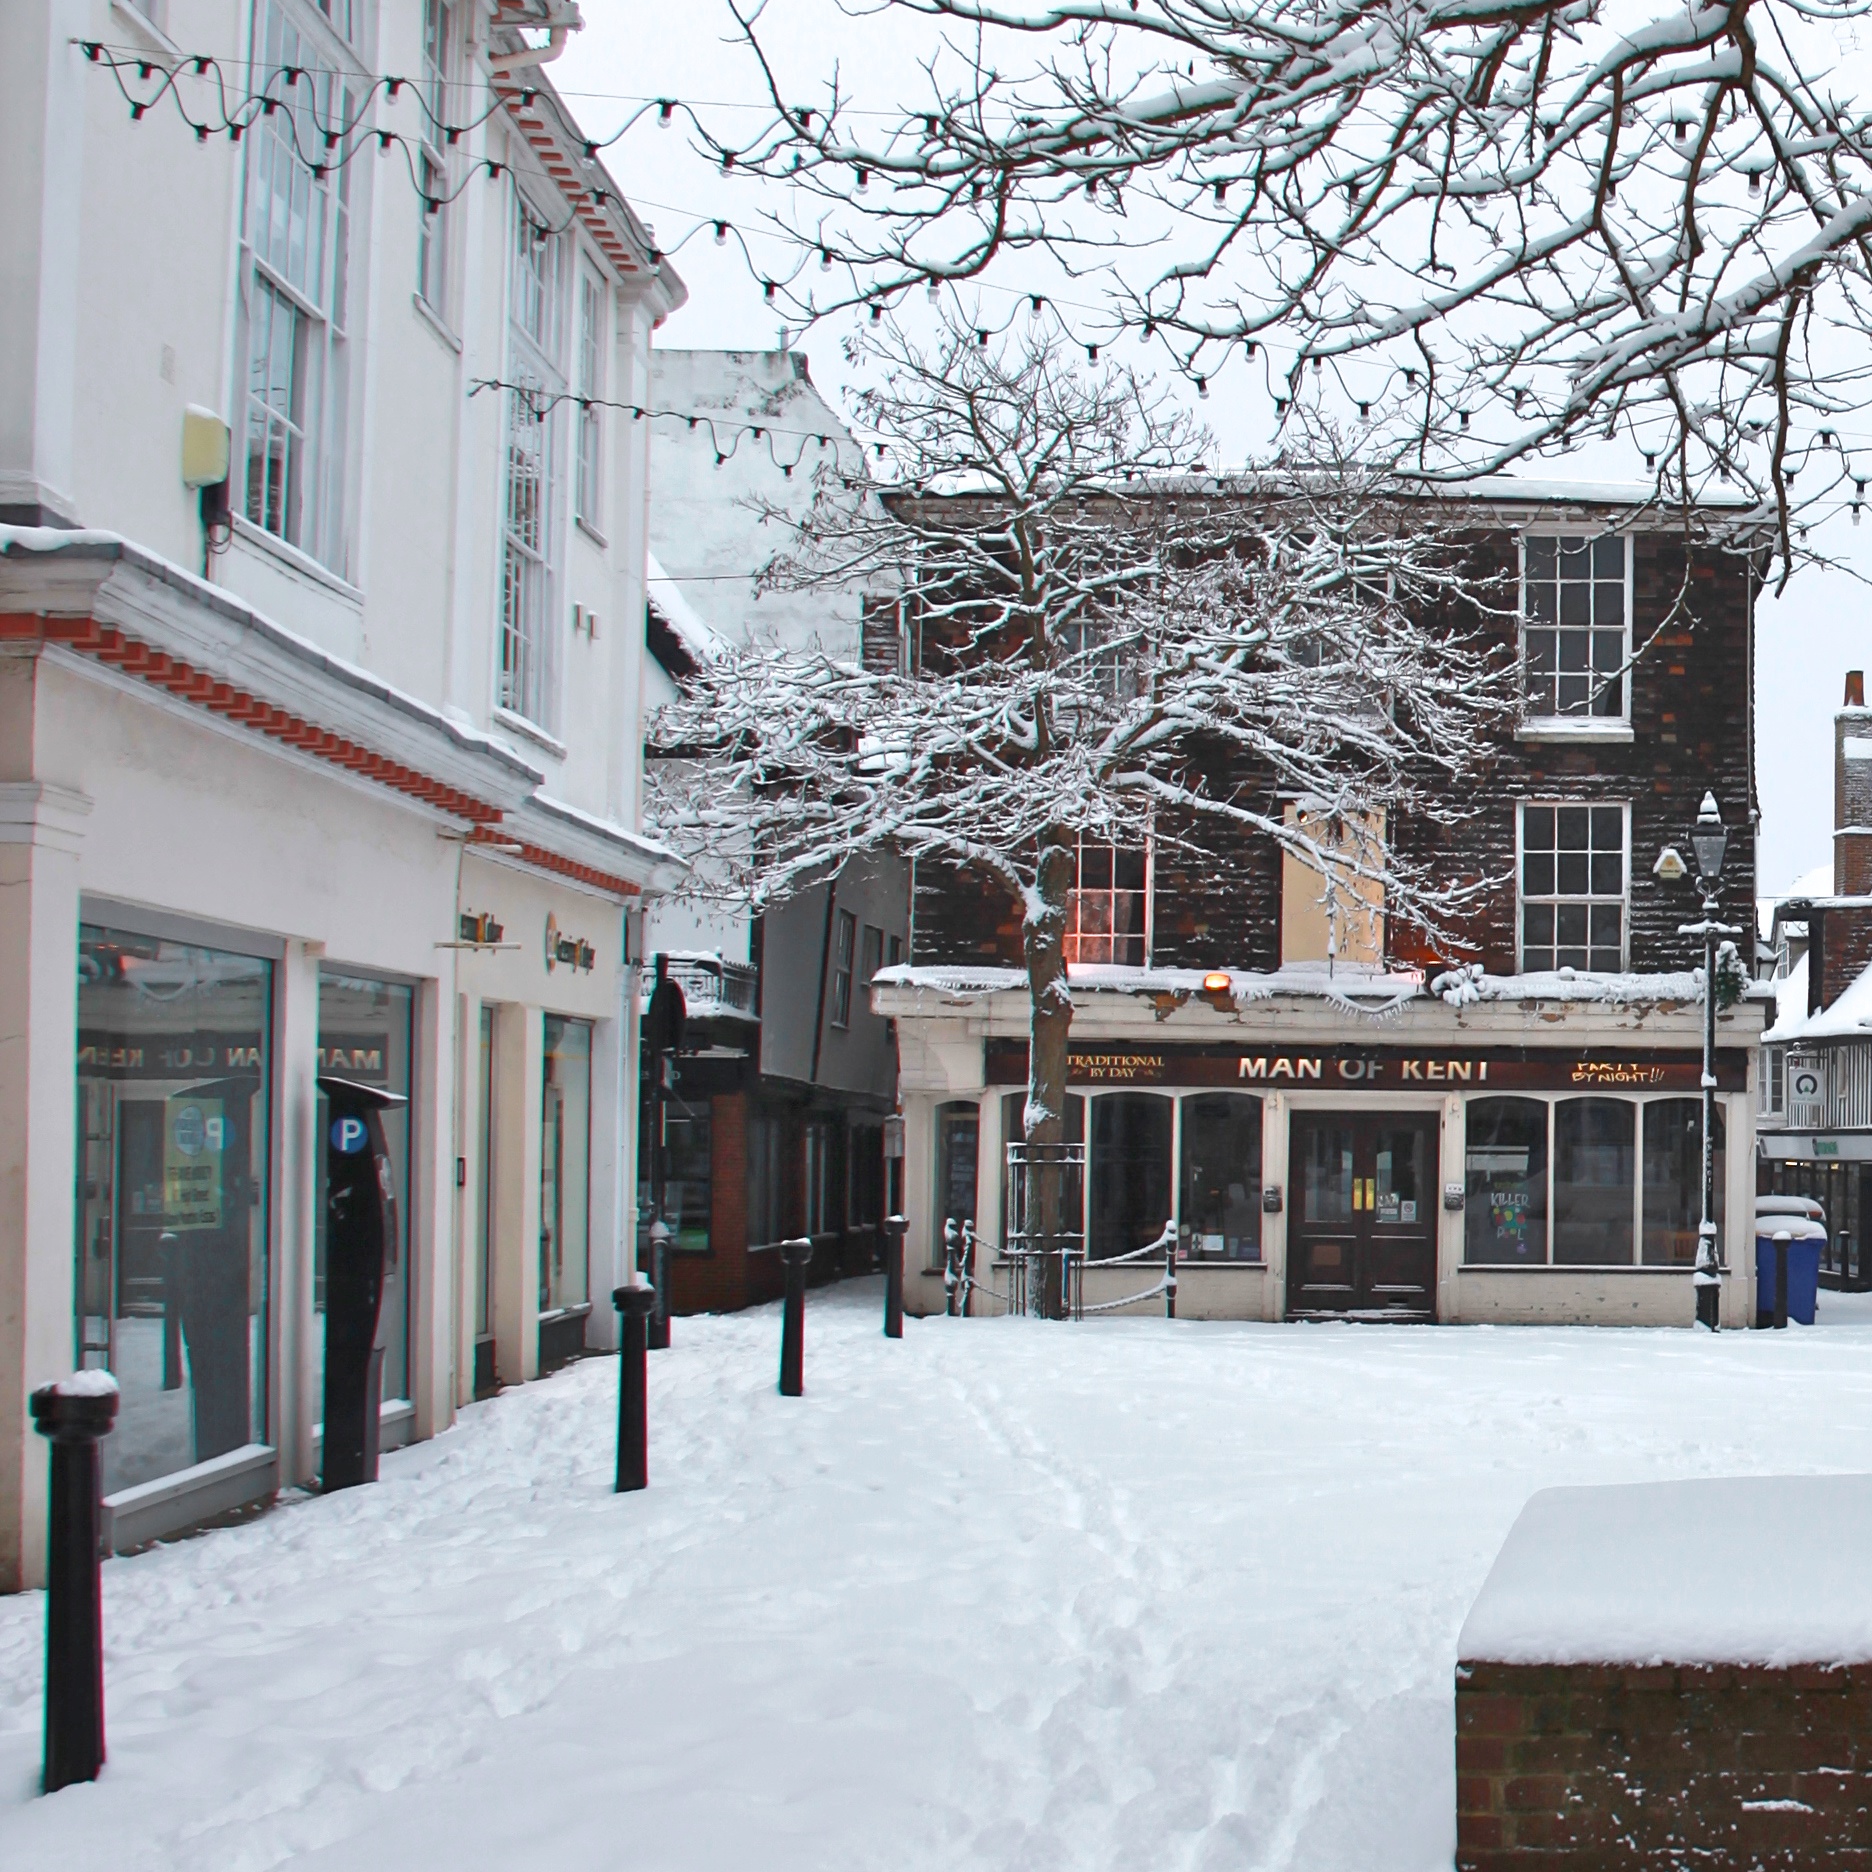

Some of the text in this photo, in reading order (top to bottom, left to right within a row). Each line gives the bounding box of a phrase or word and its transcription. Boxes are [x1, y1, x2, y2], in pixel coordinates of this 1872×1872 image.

[1066, 1055, 1165, 1067] TRADITIONAL
[1090, 1068, 1137, 1078] BY DAY
[1238, 1057, 1322, 1078] MAN
[1338, 1059, 1384, 1080] OF
[1571, 1071, 1595, 1082] BY
[1491, 1192, 1530, 1208] KILLER
